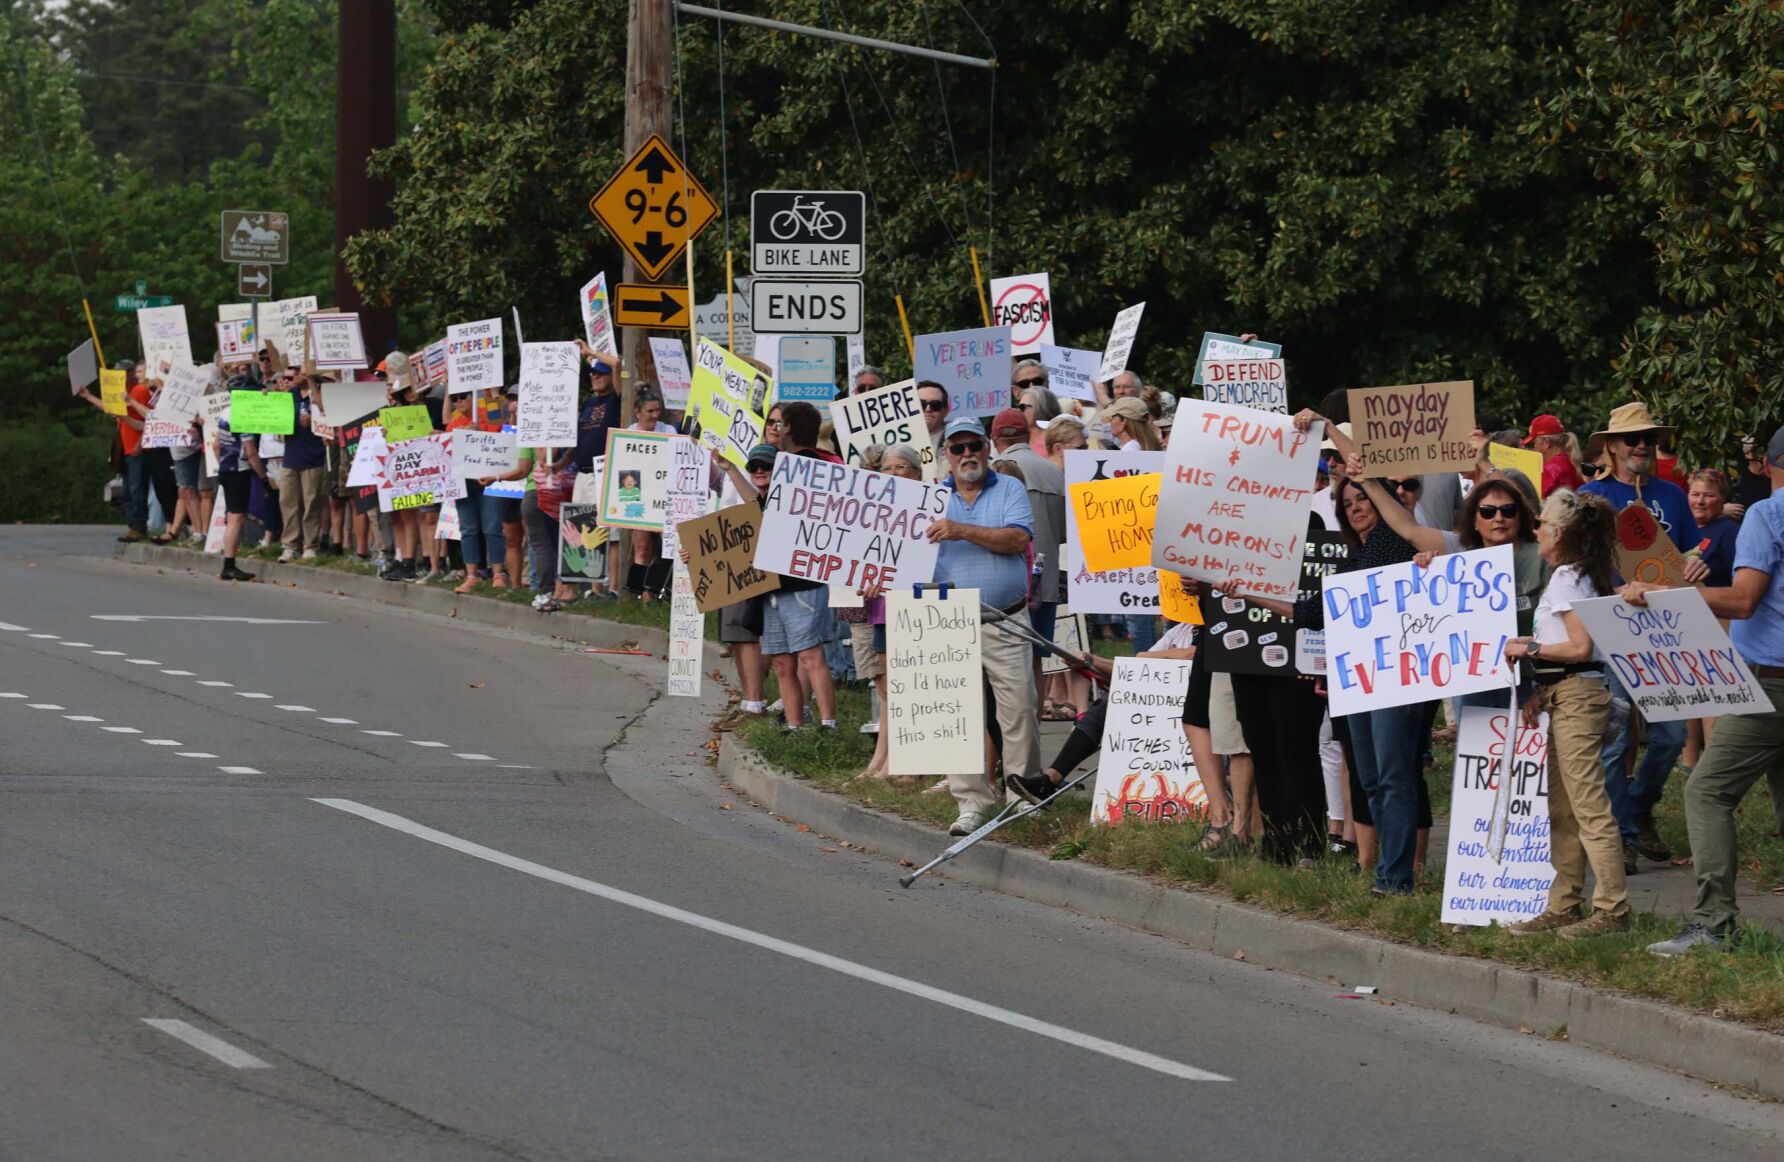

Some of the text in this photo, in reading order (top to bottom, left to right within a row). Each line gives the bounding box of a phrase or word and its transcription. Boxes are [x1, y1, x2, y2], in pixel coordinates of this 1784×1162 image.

[766, 250, 850, 265] BIKE LANE
[118, 297, 148, 308] Wiley
[768, 295, 846, 320] ENDS
[994, 300, 1050, 326] FASCISM
[458, 324, 490, 336] THE POWER
[449, 336, 500, 354] OF THE PEOPLE
[930, 339, 1004, 366] VETERANS
[698, 344, 723, 375] YOUR
[957, 364, 982, 379] FOR
[1208, 363, 1282, 382] DEFEND
[784, 387, 829, 396] 982-2222
[966, 390, 1008, 410] RIGHTS
[1206, 382, 1285, 404] DEMOCRACY
[844, 386, 920, 434] LIBERE
[1364, 385, 1450, 422] mayday
[345, 427, 358, 440] WE
[730, 409, 759, 450] ROT
[1201, 413, 1308, 459] TRUMP
[1367, 412, 1448, 443] mayday
[465, 434, 496, 444] Tariffs
[626, 443, 658, 454] FACES
[396, 450, 424, 462] MAY
[464, 456, 480, 464] Feed
[675, 442, 704, 466] HANDS
[1361, 443, 1420, 468] Fascism
[395, 460, 422, 472] DAY
[656, 470, 668, 480] OF
[773, 454, 948, 514] AMERICA IS
[1175, 464, 1310, 504] HIS CABINET
[392, 492, 432, 509] FAILING
[765, 483, 782, 512] A
[1083, 491, 1138, 526] Bring
[1208, 501, 1246, 518] ARE
[700, 516, 754, 556] No Kings
[796, 520, 903, 566] NOT AN
[1181, 523, 1297, 561] MORONS!
[1163, 546, 1198, 568] God
[1321, 542, 1348, 559] ON
[714, 560, 725, 572] in
[790, 550, 897, 594] EMPIRE
[1304, 562, 1337, 577] THE
[1324, 555, 1512, 629] DUE PROCESS
[894, 604, 977, 644] My Daddy
[1248, 608, 1272, 622] OF
[1613, 604, 1682, 636] Save
[1400, 612, 1454, 650] for
[1648, 631, 1684, 648] our
[930, 644, 972, 664] enlist
[1335, 630, 1508, 694] EVERYONE!
[1118, 664, 1171, 684] WE ARE
[1610, 648, 1746, 689] DEMOCRACY
[936, 674, 968, 690] have
[890, 700, 964, 725] to protest
[1131, 713, 1156, 726] OF
[896, 717, 968, 746] this shit!
[1109, 732, 1172, 754] WITCHES
[1510, 799, 1532, 816] ON
[1500, 843, 1551, 864] onstitu
[1458, 871, 1487, 888] our
[1450, 896, 1479, 910] our
